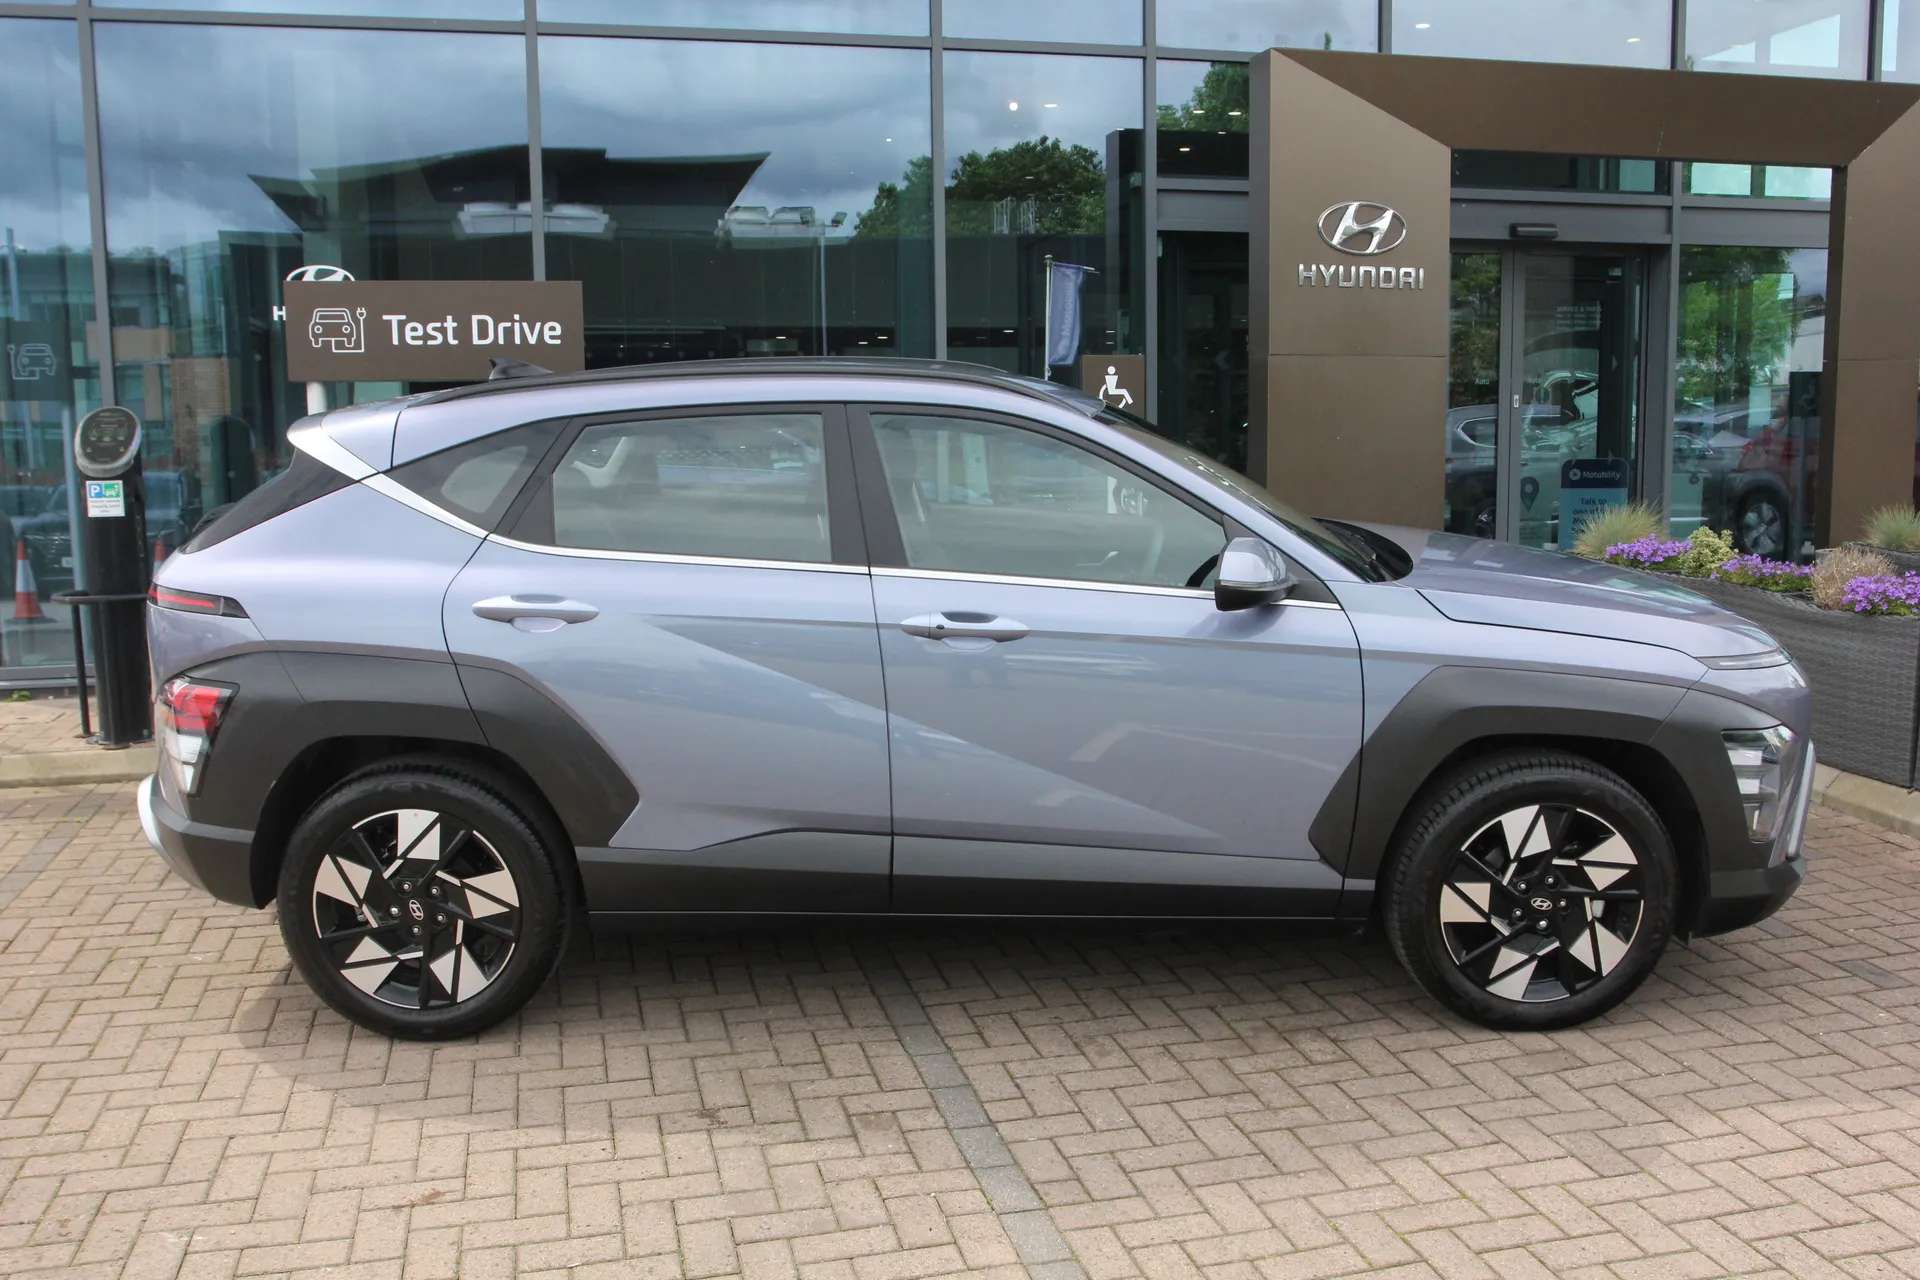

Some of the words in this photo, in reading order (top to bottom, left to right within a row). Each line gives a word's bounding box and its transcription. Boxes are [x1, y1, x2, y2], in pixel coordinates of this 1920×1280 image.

[1298, 263, 1425, 289] HYUNDAI
[382, 314, 459, 346] Test
[471, 313, 562, 345] Drive
